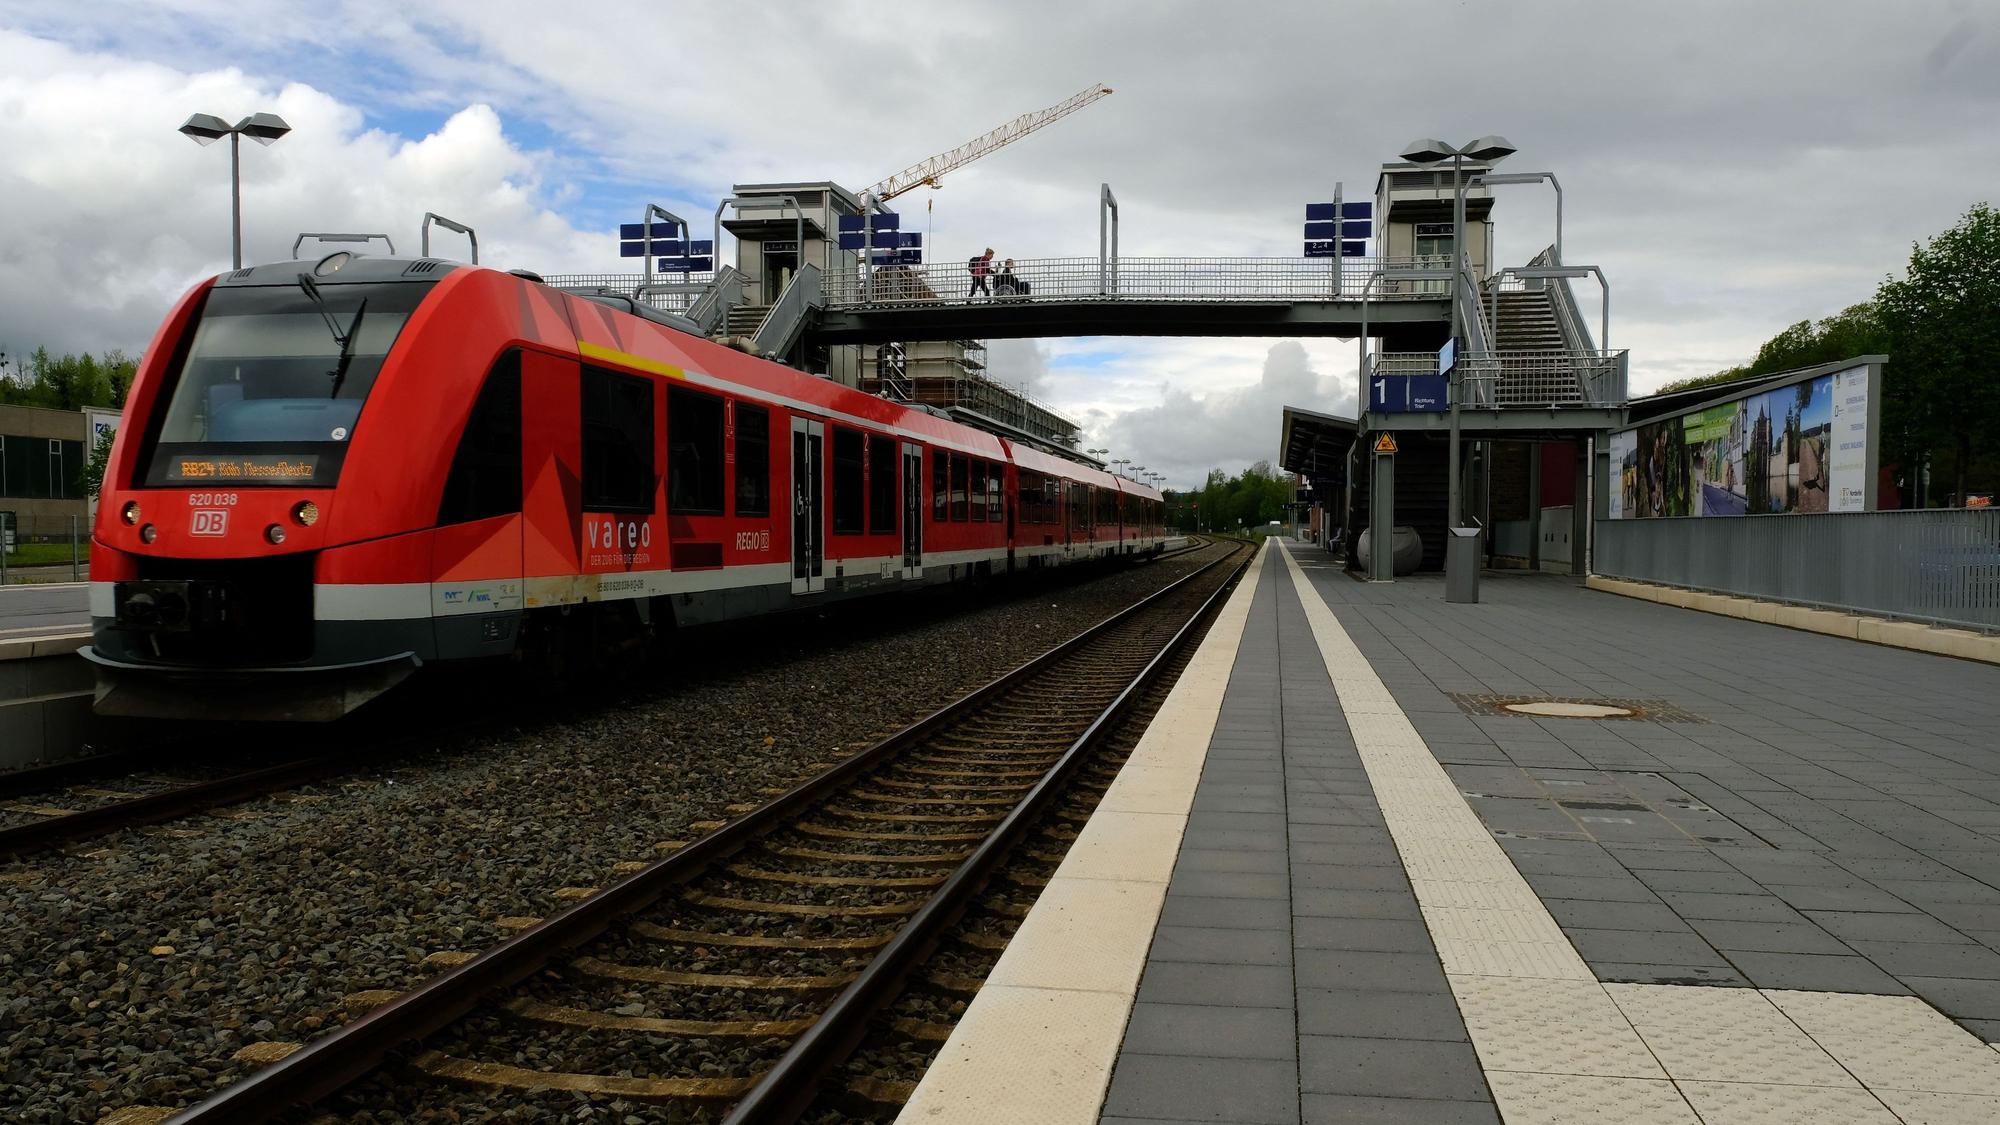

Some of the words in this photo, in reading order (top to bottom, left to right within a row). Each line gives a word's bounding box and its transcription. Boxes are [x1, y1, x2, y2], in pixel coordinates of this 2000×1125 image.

[1375, 379, 1386, 404] 1
[726, 400, 732, 425] 1
[864, 432, 869, 451] 2
[181, 462, 216, 477] RB24
[188, 494, 212, 506] 620
[214, 494, 238, 506] 038
[193, 511, 226, 534] DB
[588, 521, 650, 549] vareo
[736, 531, 760, 551] REGIO
[591, 554, 601, 566] DER
